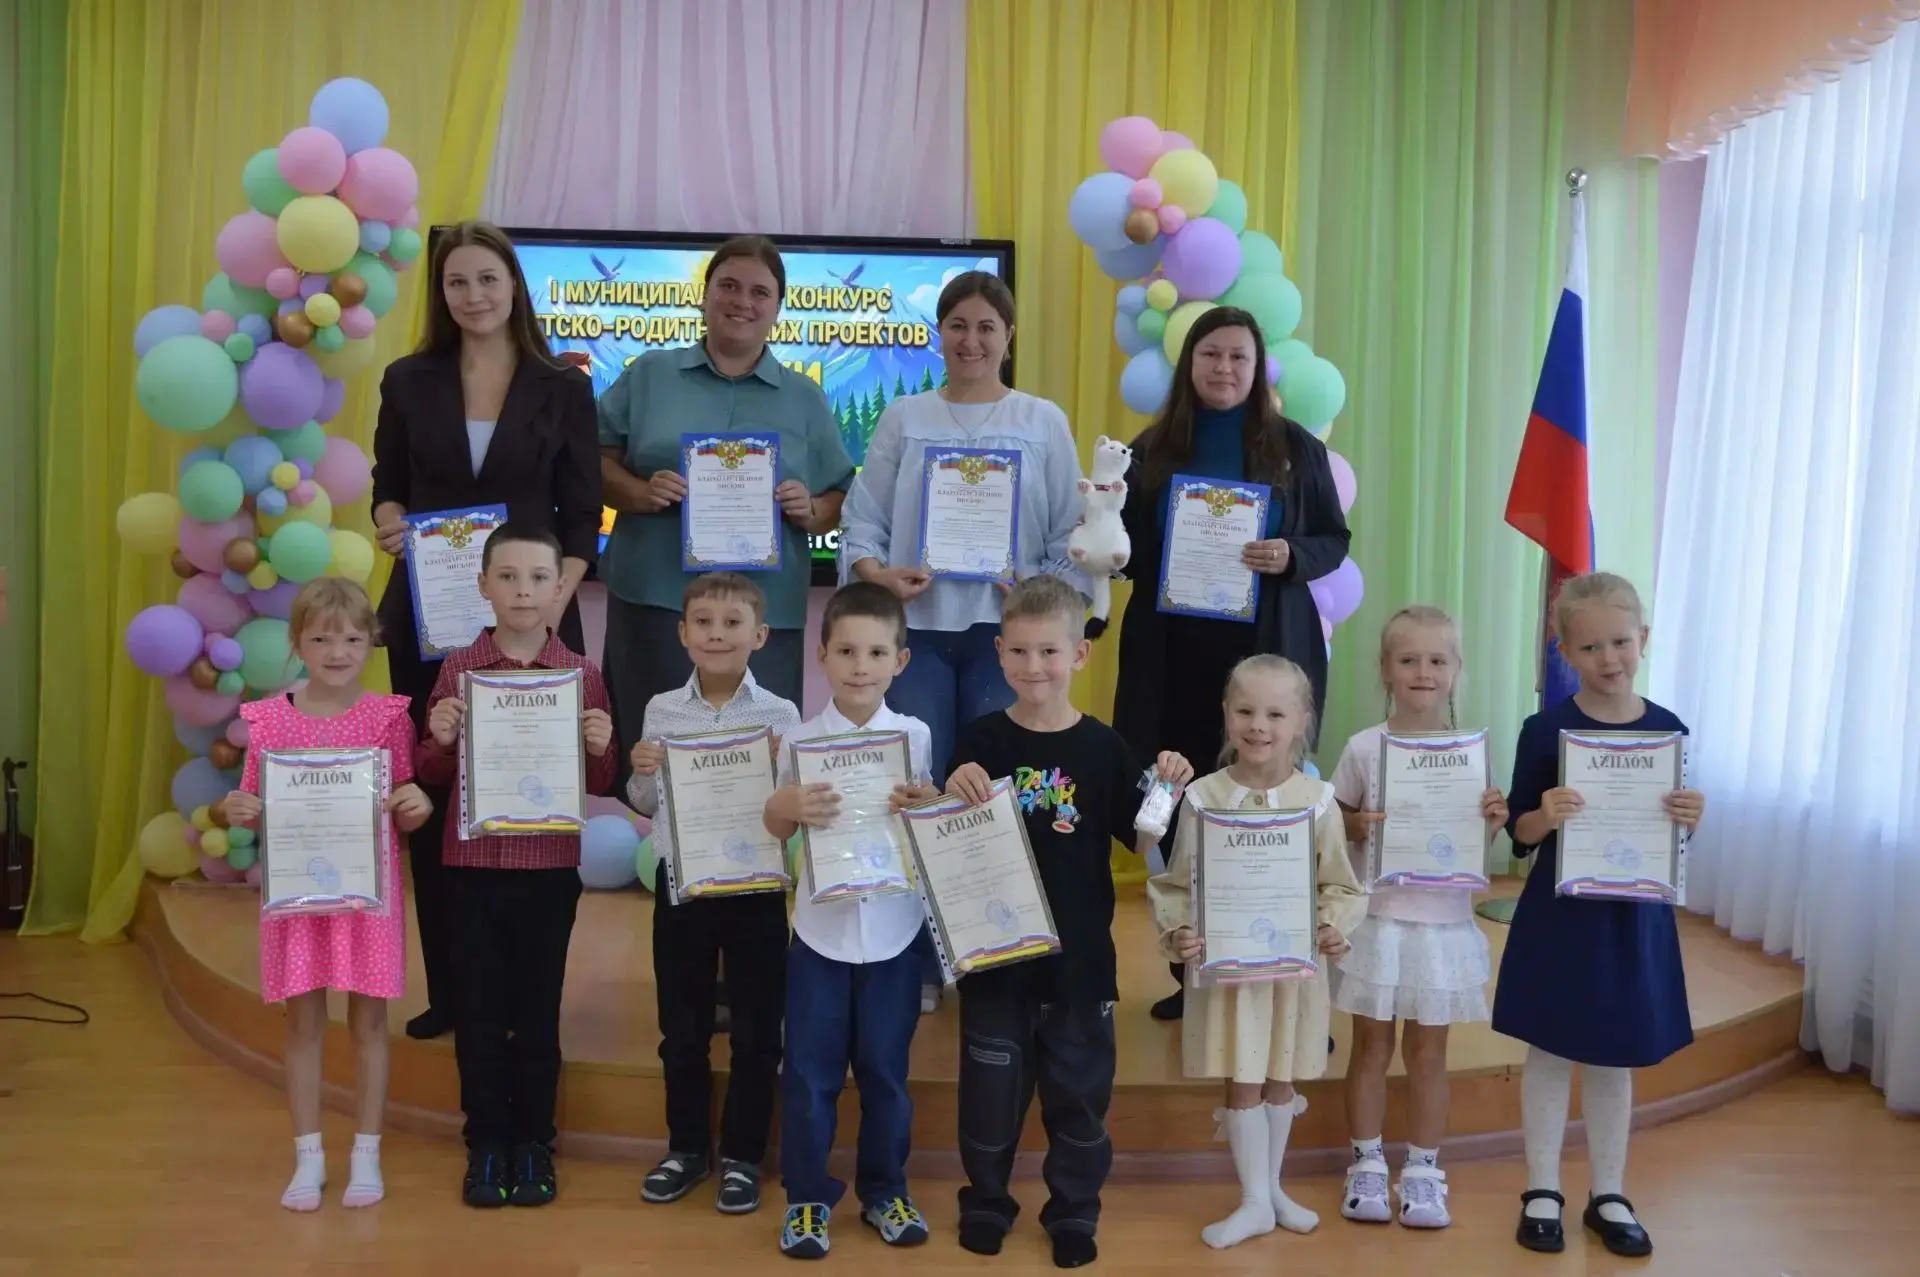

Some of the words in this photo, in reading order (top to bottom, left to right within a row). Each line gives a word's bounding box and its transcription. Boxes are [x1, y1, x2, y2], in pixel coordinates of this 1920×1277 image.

[565, 281, 706, 310] МУНИЦИПА
[785, 286, 893, 311] КОНКУРС
[808, 320, 929, 347] ПРОЕКТОВ
[493, 693, 557, 709] ДИПЛОМ
[690, 751, 752, 771] ДИПЛОМ
[820, 751, 884, 772] ДИПЛОМ
[1406, 754, 1468, 770] ДИПЛОМ
[1587, 755, 1654, 770] ДИПЛОМ
[287, 771, 353, 787] ДИПЛОМ
[936, 808, 995, 839] ДИПЛОМ
[1224, 832, 1289, 848] ДИПЛОМ
